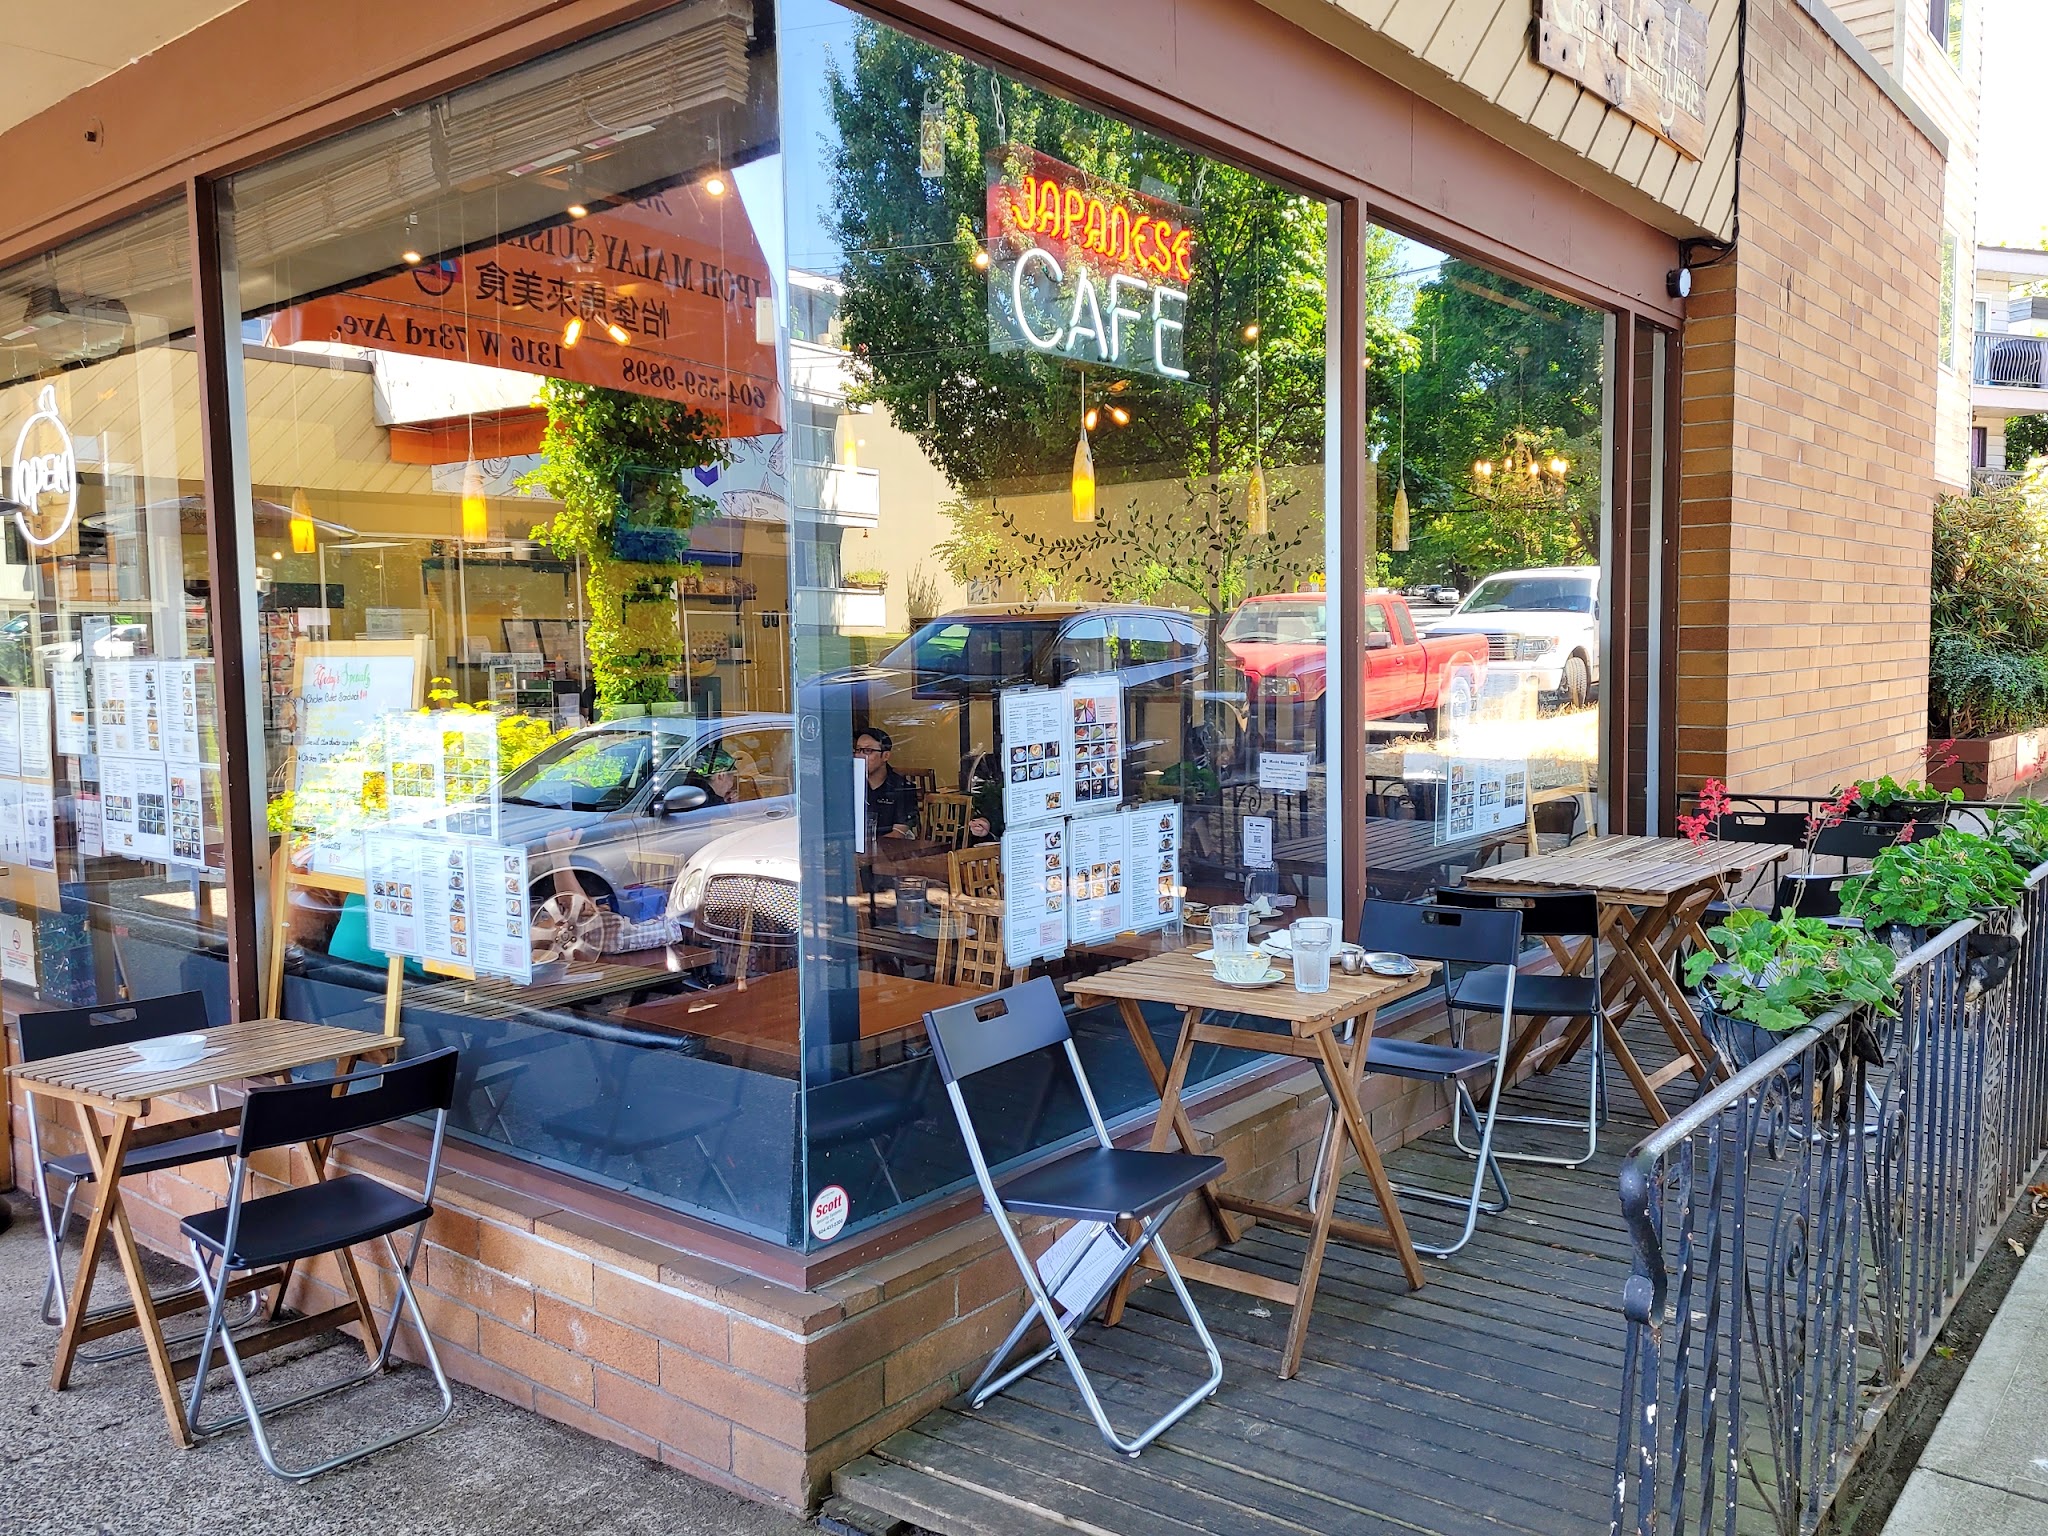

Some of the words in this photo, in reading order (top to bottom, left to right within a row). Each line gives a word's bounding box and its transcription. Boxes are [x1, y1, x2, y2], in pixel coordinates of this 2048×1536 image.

[1010, 174, 1193, 281] JAPANESE
[1013, 247, 1190, 380] CAFE
[17, 452, 71, 515] OPEN
[816, 1194, 842, 1218] Scott
